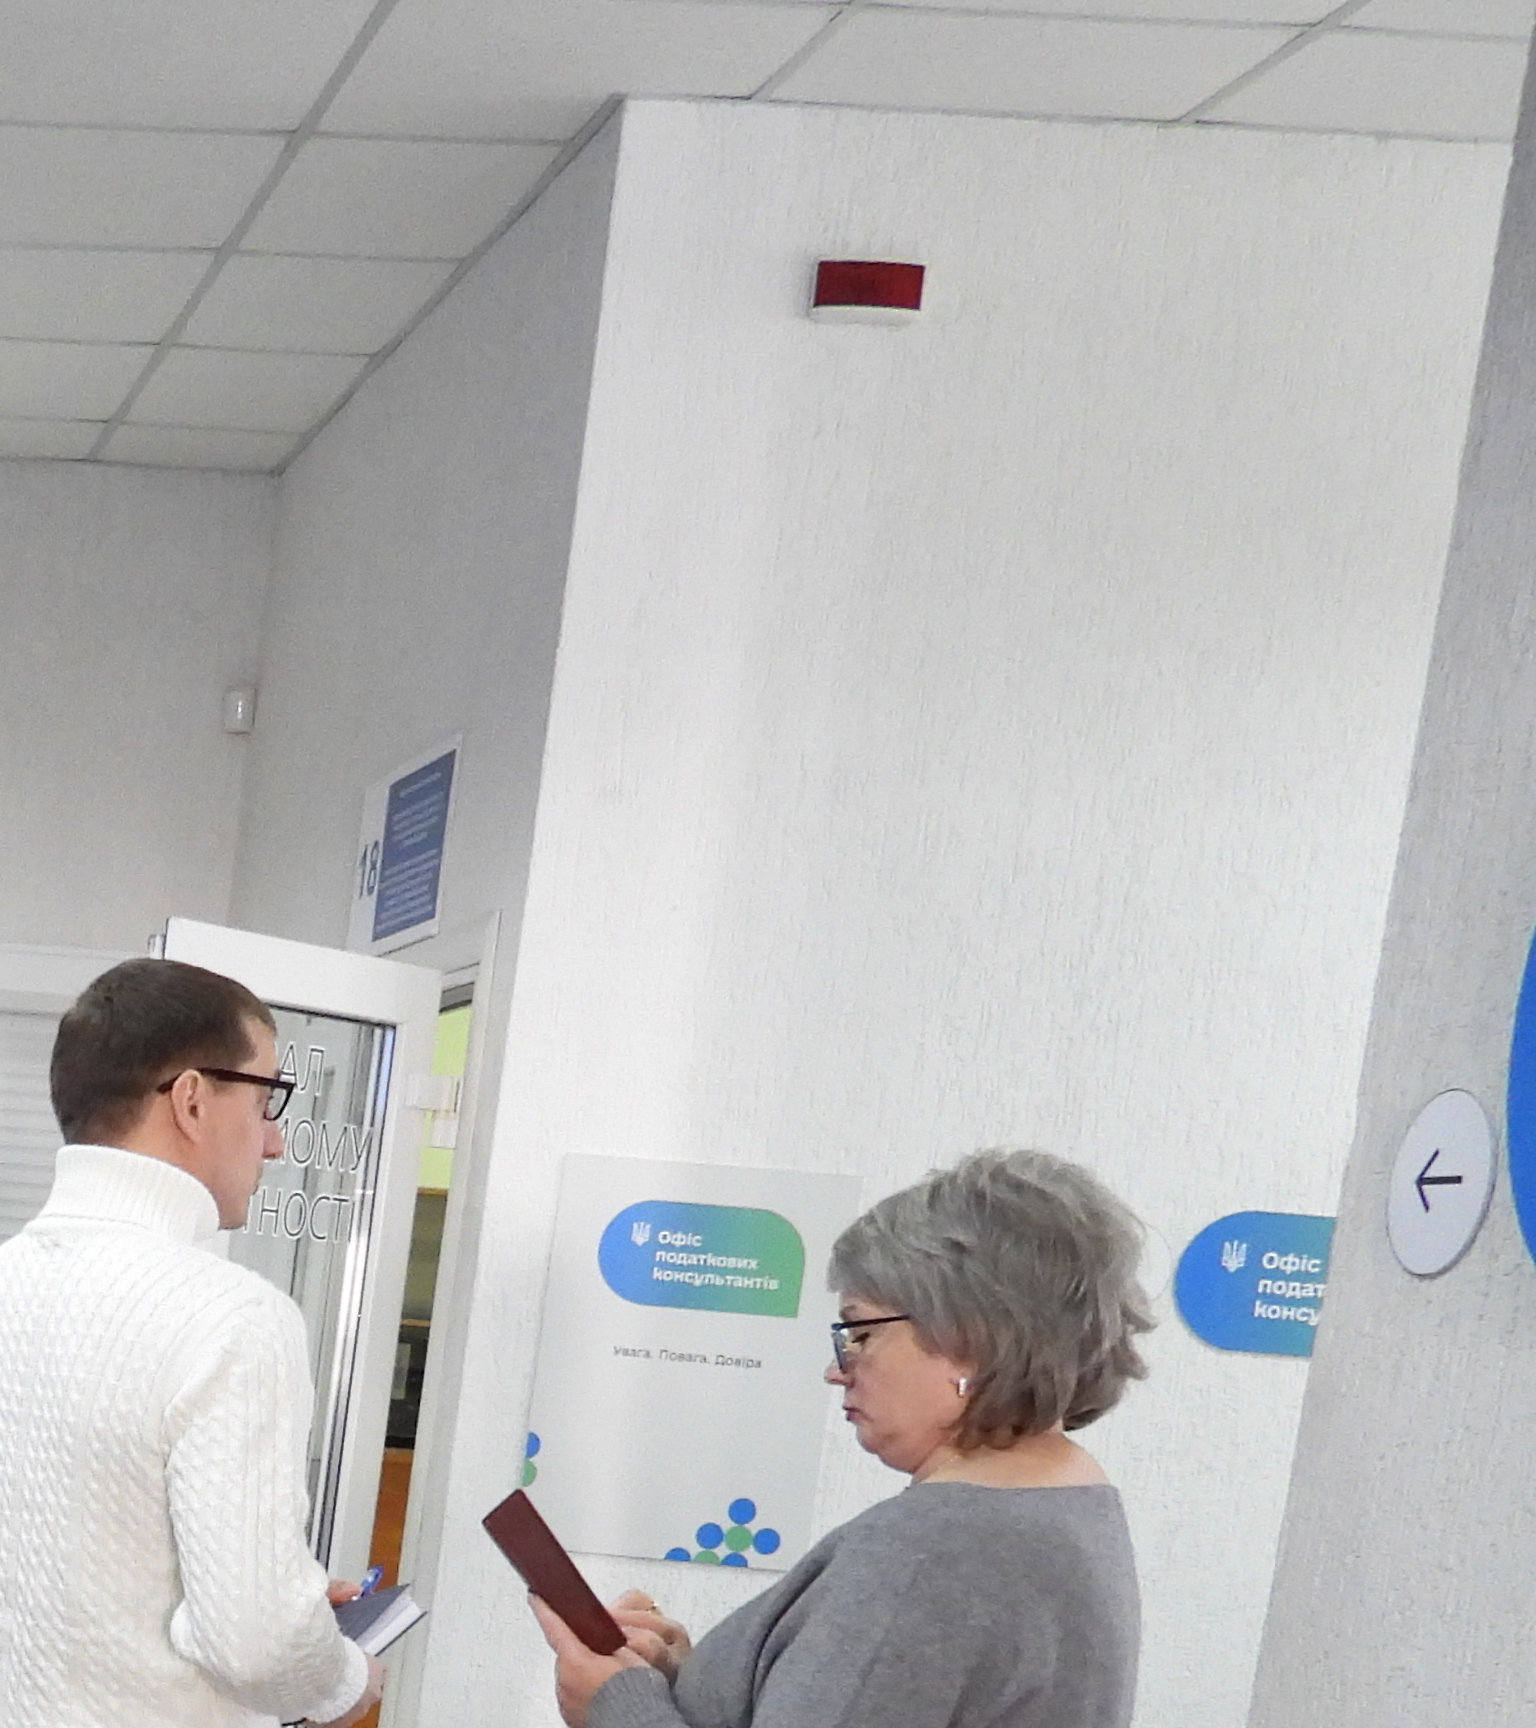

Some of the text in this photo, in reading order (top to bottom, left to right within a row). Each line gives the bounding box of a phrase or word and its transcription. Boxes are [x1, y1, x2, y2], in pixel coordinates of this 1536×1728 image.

[244, 1186, 356, 1246] НОСТІ
[658, 1230, 703, 1248] Офіс
[654, 1249, 760, 1271] податкових
[1262, 1251, 1322, 1275] Офіс
[652, 1266, 779, 1291] консультантів
[659, 1349, 710, 1364] Повага.
[714, 1354, 762, 1369] Довіра
